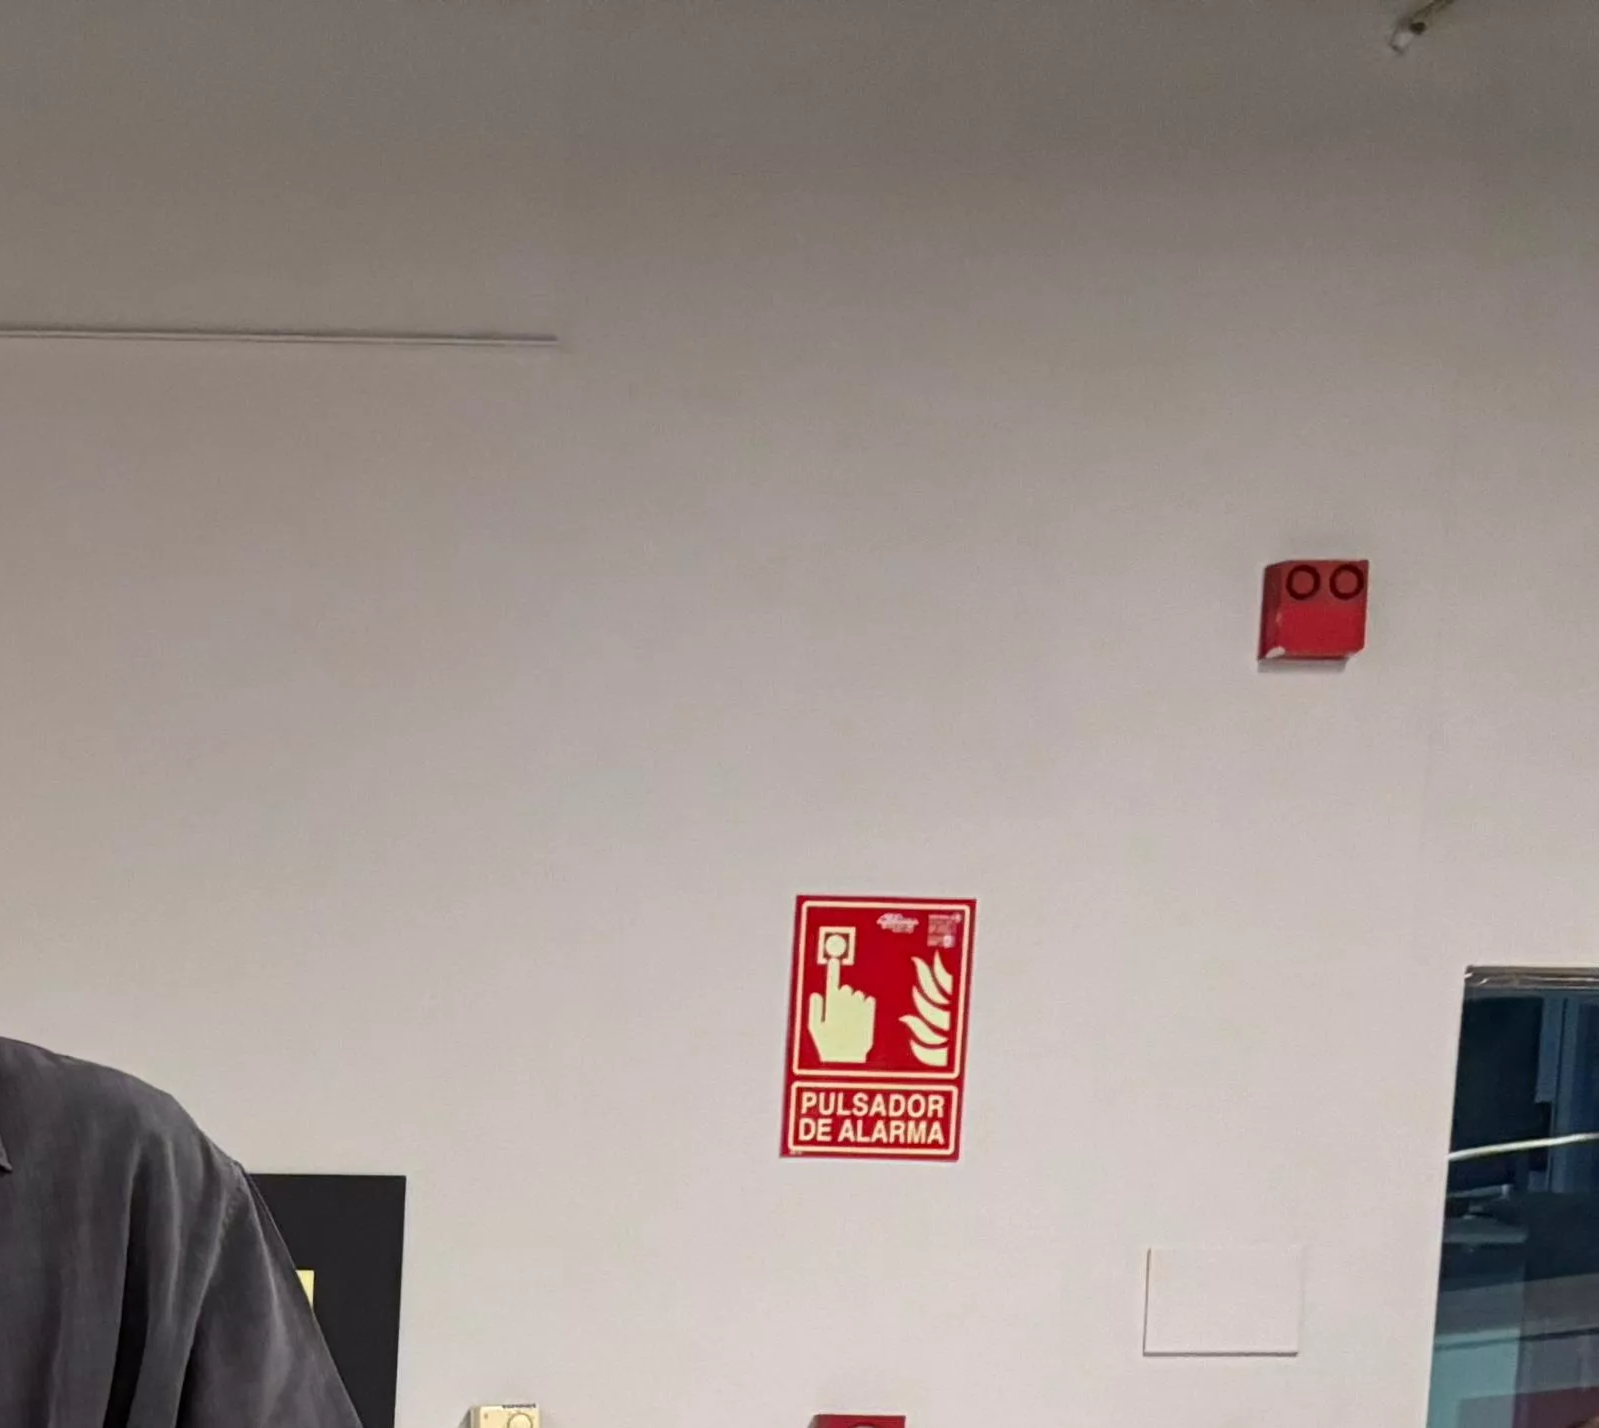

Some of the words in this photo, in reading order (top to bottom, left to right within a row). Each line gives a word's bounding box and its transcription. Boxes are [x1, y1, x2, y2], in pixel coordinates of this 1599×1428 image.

[801, 1091, 944, 1118] PULSADOR
[798, 1118, 832, 1142] DE
[838, 1119, 945, 1145] ALARMA
